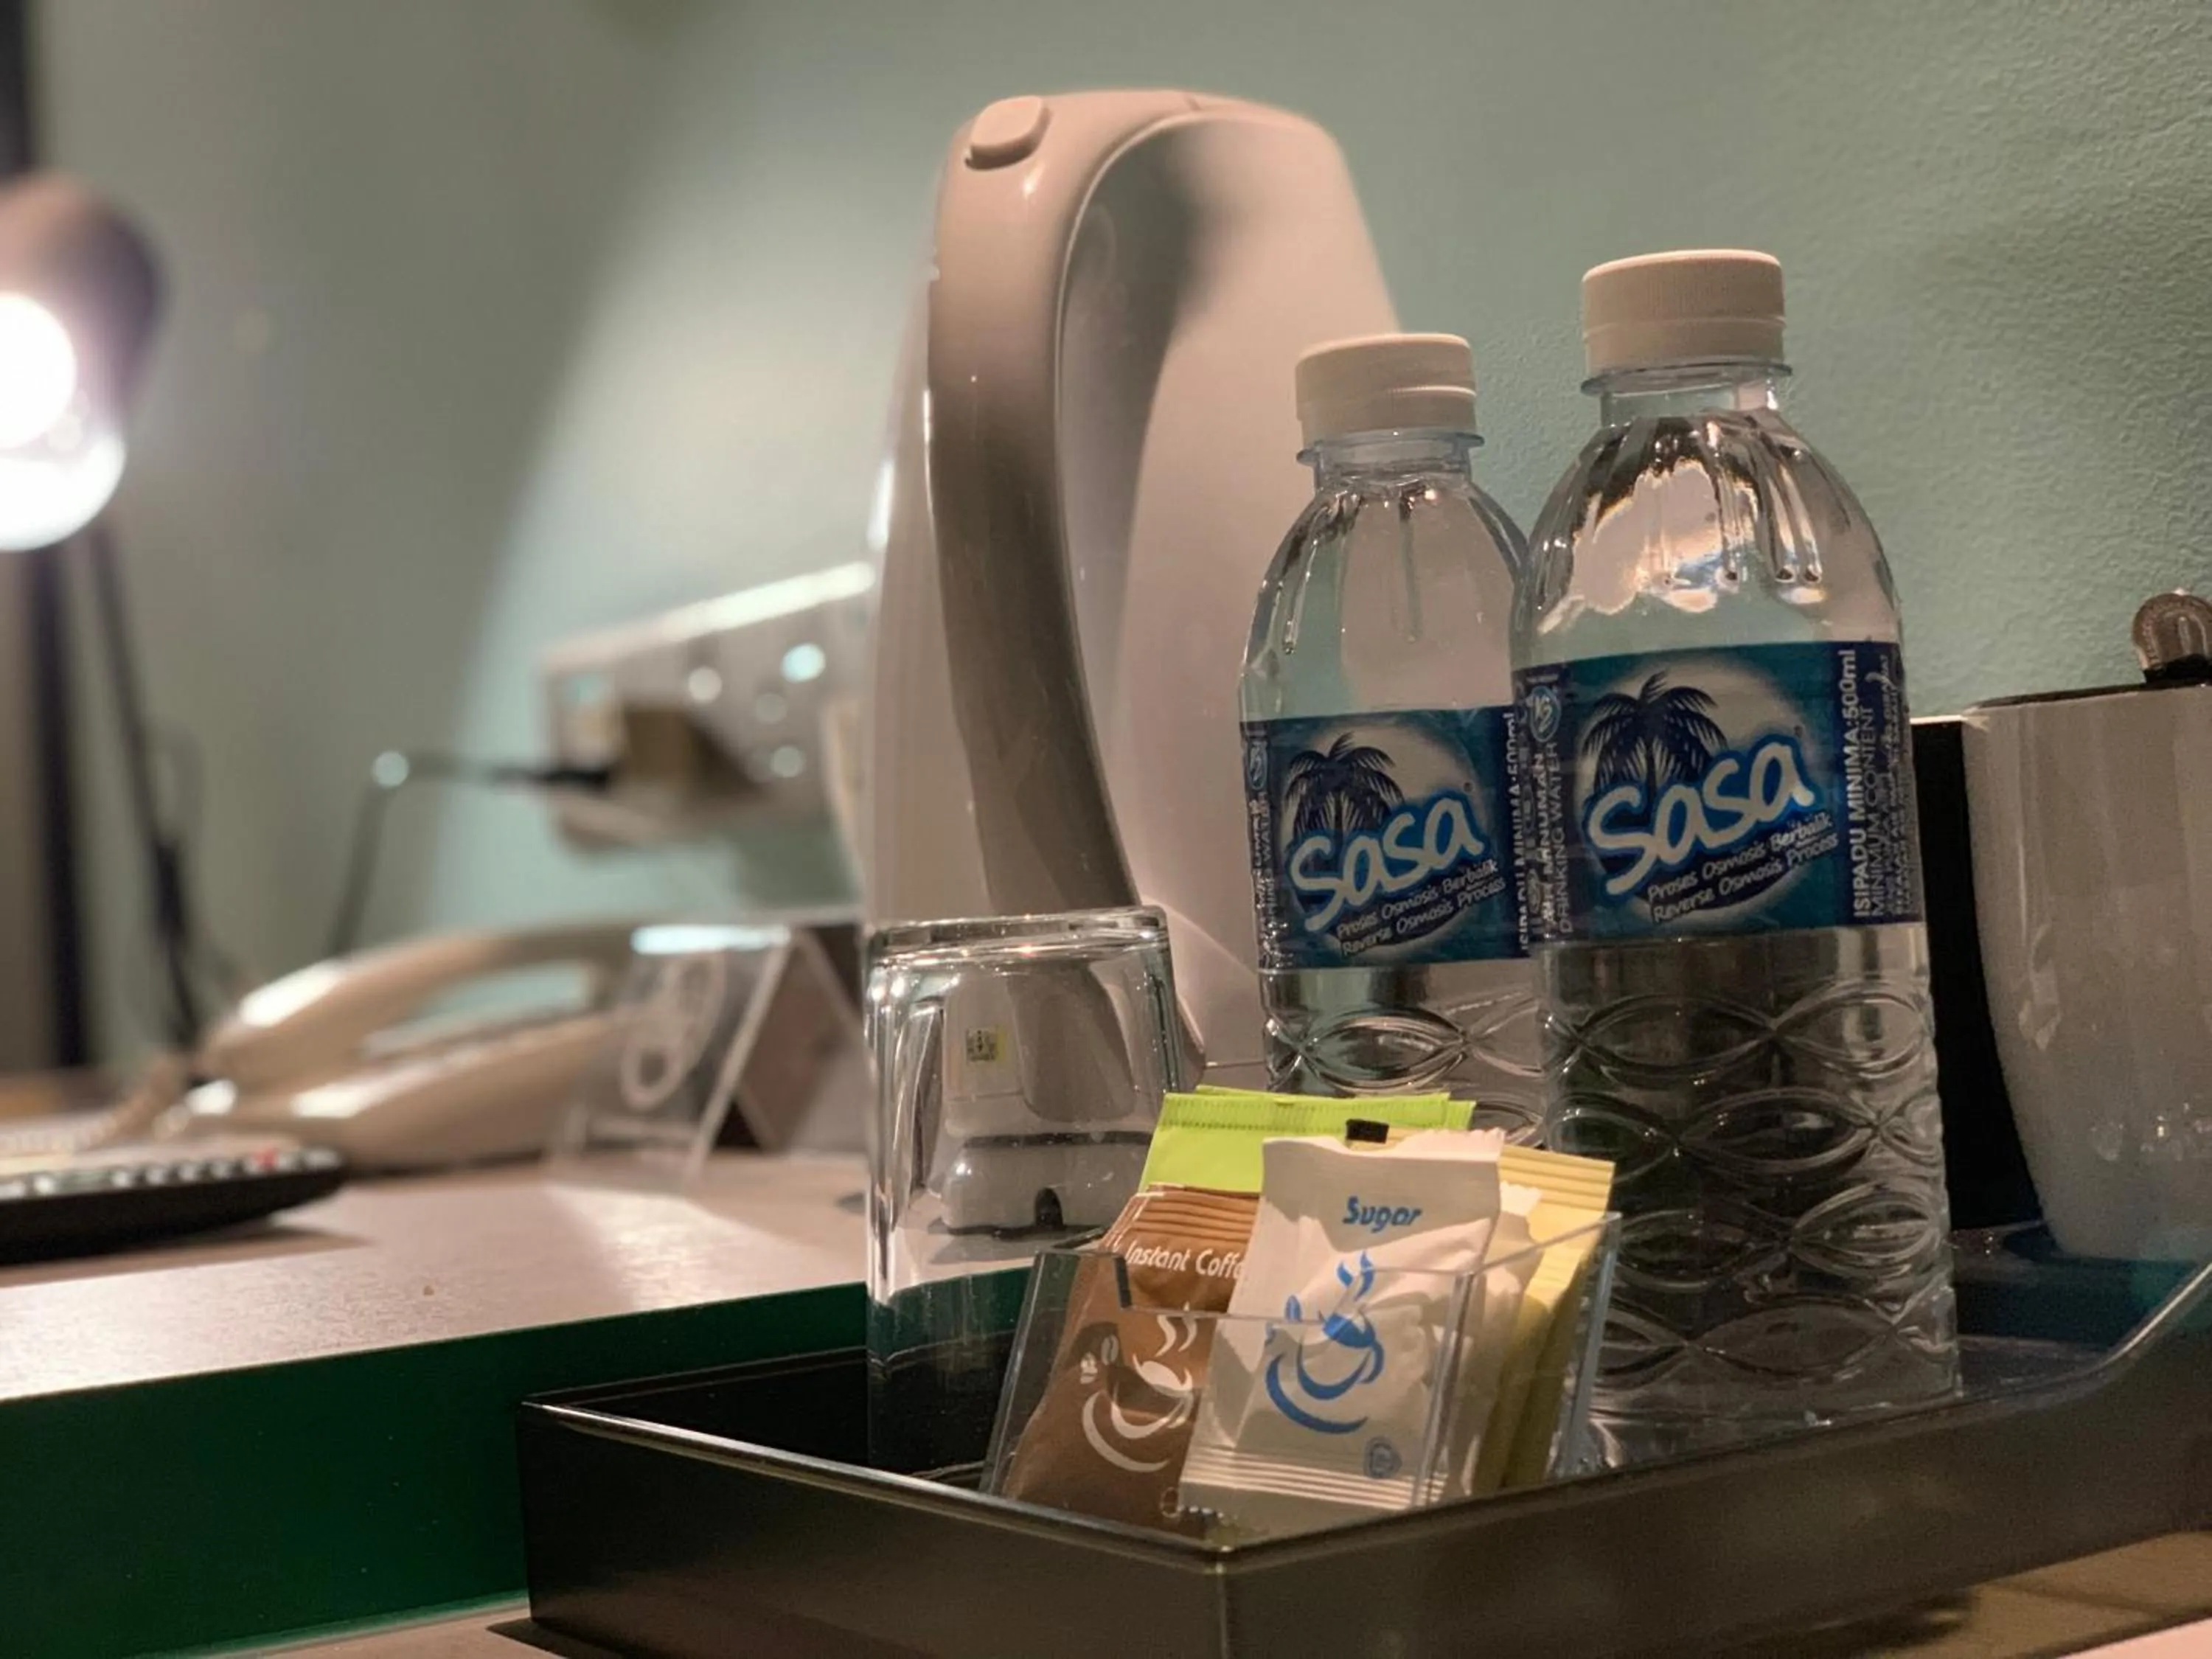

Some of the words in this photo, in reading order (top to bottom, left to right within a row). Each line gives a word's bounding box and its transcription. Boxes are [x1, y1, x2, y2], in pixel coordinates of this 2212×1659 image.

[1547, 742, 1562, 821] WATER
[1860, 706, 1877, 807] CONTENT
[1382, 886, 1438, 919] Osmosis
[1551, 827, 1573, 933] DRINKING
[1647, 872, 1699, 902] Proses
[1703, 840, 1767, 879] Osmosis
[1653, 888, 1716, 922] Reverse
[1718, 856, 1784, 896] Osmosis
[1785, 833, 1838, 867] Process
[1848, 827, 1871, 917] ISIPADU
[1866, 813, 1885, 917] MINIMUM
[1397, 898, 1453, 934] Osmosis
[1458, 877, 1506, 908] Process
[1341, 1195, 1422, 1234] Sugar
[1125, 1239, 1191, 1272] Instant
